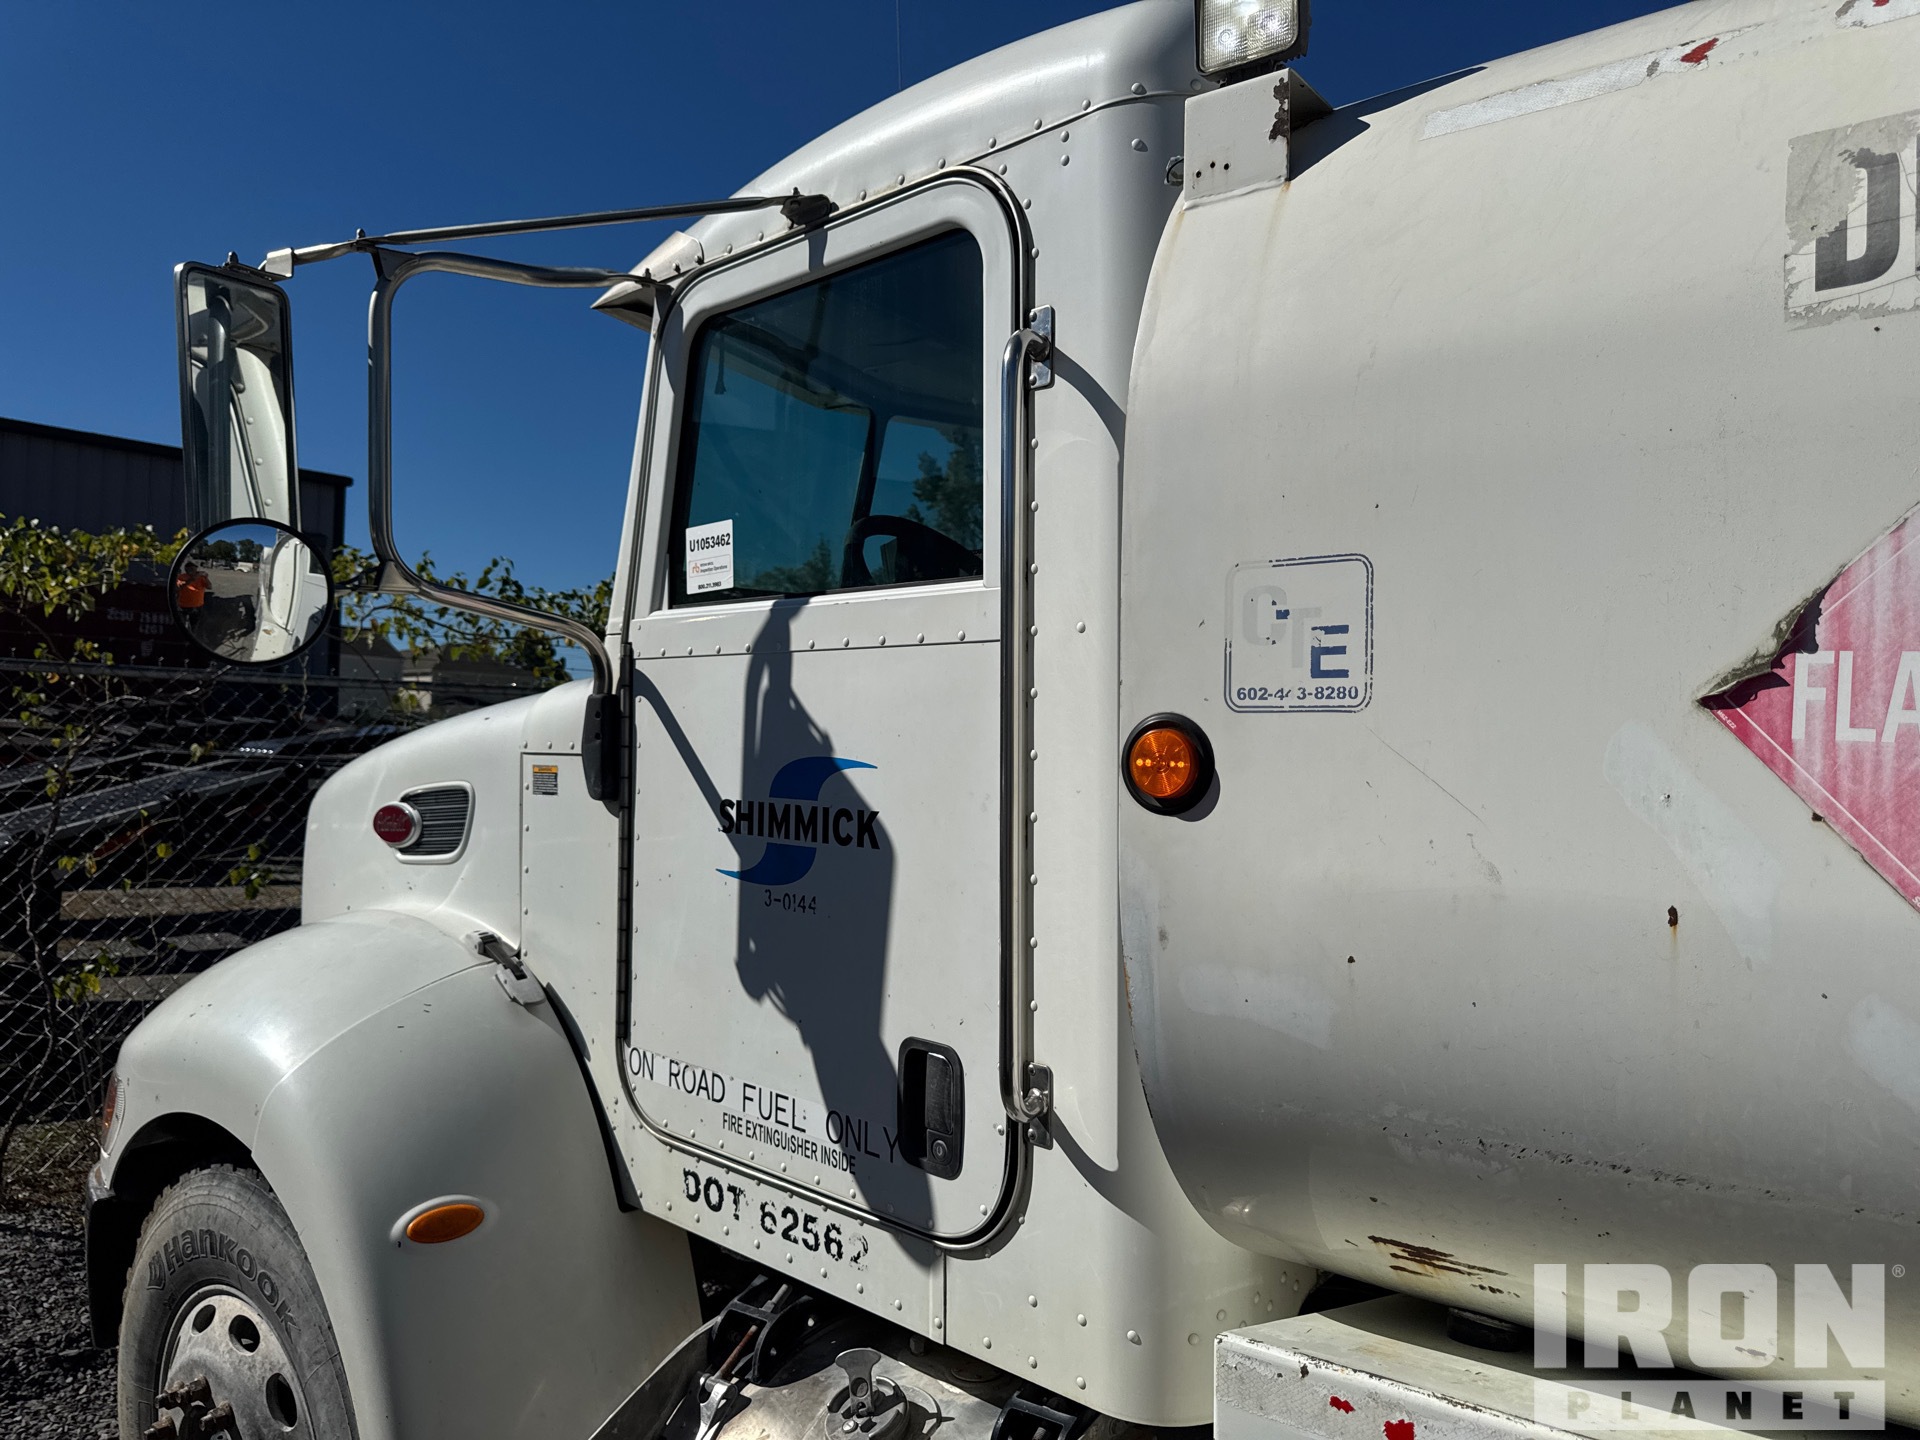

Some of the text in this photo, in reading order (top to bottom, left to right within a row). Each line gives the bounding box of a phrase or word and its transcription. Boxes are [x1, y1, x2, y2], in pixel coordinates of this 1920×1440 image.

[689, 533, 731, 552] U1053462
[719, 799, 880, 849] SHIMMICK
[764, 889, 817, 914] 3-0144
[629, 1047, 899, 1163] ON ROAD FUEL ONLY
[722, 1112, 856, 1175] FIRE EXTINGUISHER INSIDE
[683, 1168, 745, 1220] DOT
